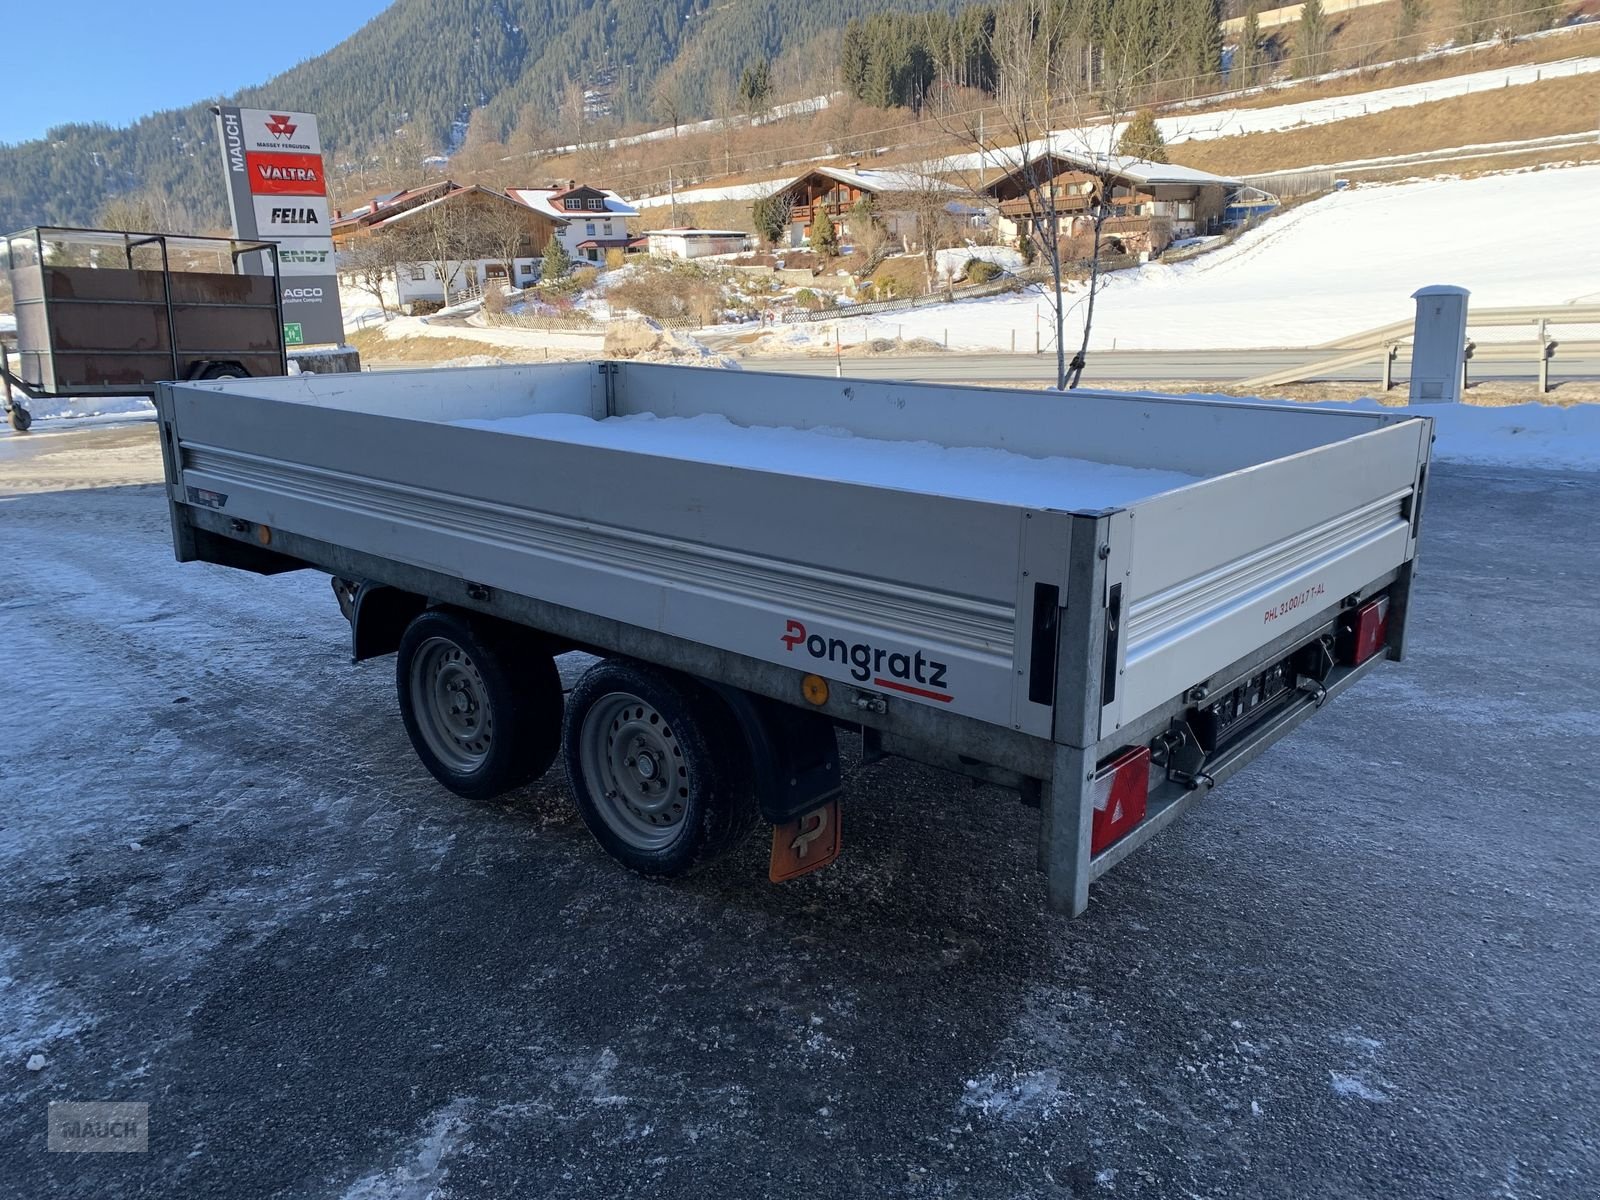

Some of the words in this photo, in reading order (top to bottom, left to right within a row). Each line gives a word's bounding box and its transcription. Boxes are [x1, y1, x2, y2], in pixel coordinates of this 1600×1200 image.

[225, 114, 244, 172] MAUCH
[258, 165, 317, 181] VALTRA
[271, 208, 318, 224] FELLA
[284, 288, 323, 297] AGCO
[1264, 607, 1278, 624] PHL
[1280, 589, 1310, 615] 3100/17
[780, 619, 947, 689] Pongratz
